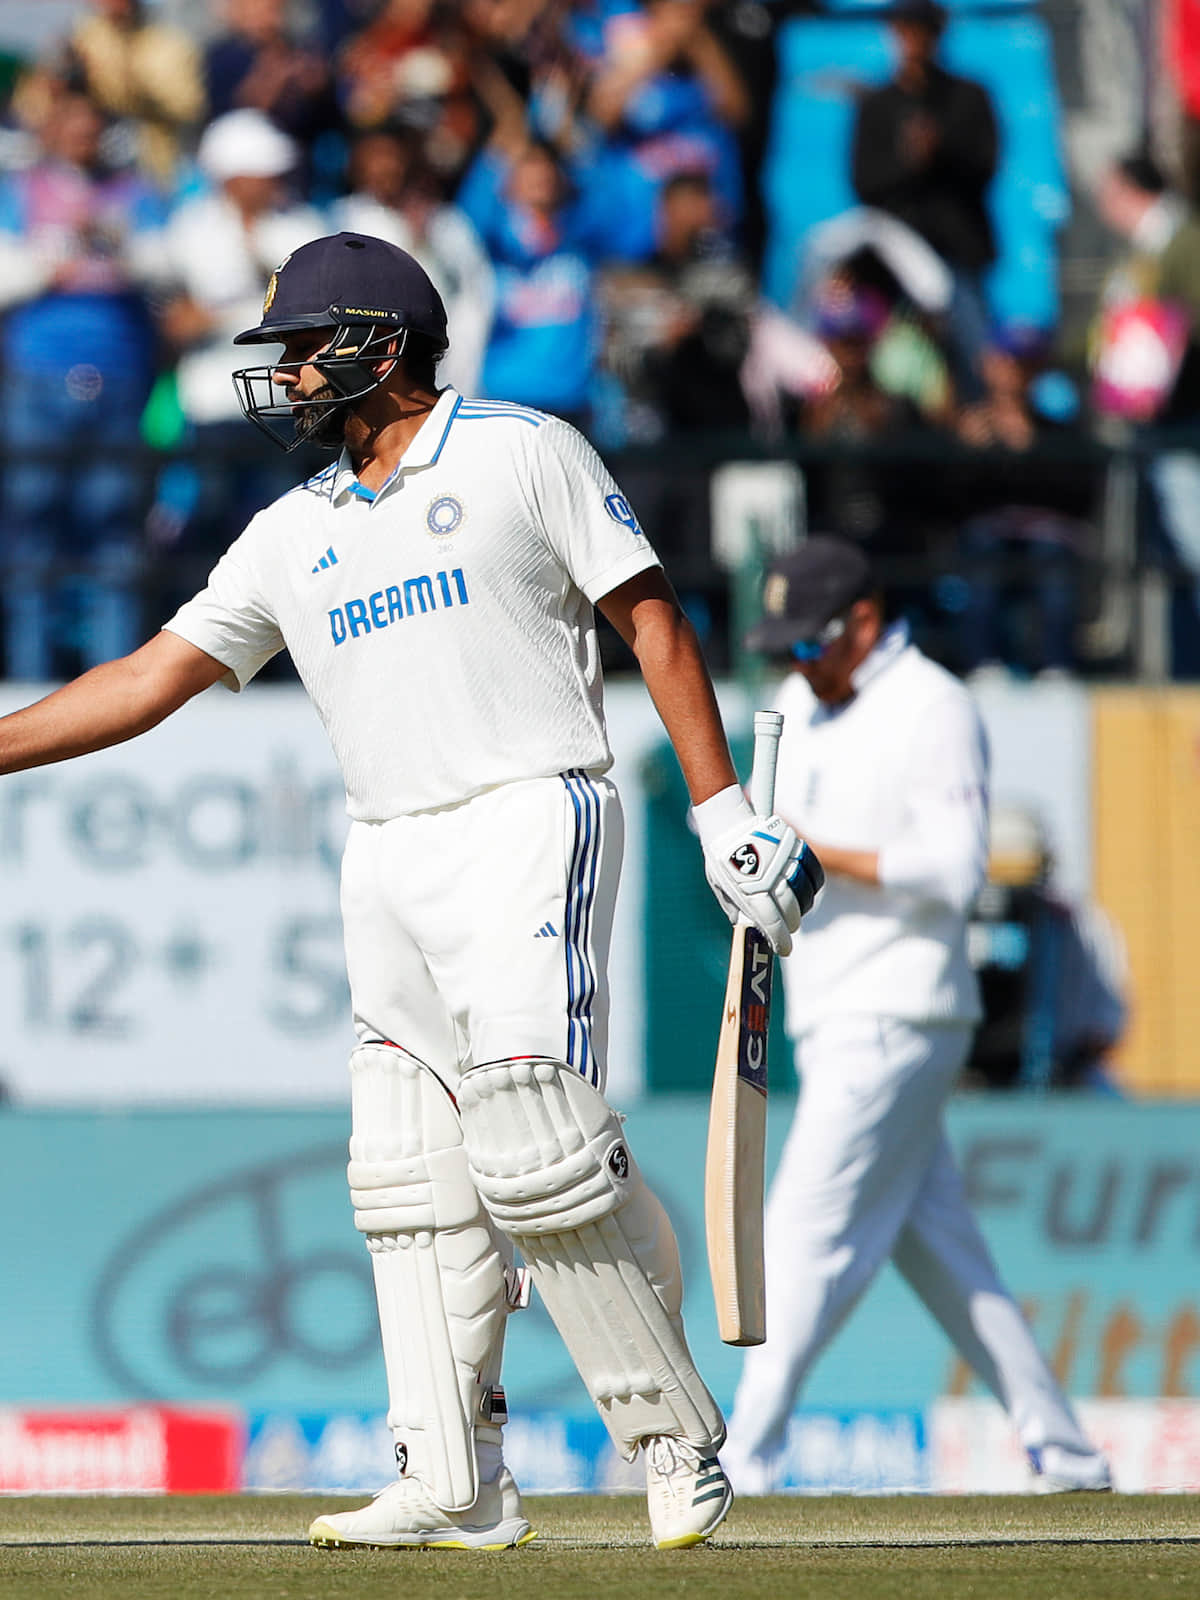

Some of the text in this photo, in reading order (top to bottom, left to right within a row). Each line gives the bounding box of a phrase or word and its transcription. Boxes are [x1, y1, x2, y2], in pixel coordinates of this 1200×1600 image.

[345, 308, 388, 318] MASURI
[328, 568, 469, 646] DREAM11
[746, 942, 768, 1071] CEAT
[962, 1132, 1200, 1250] Fur
